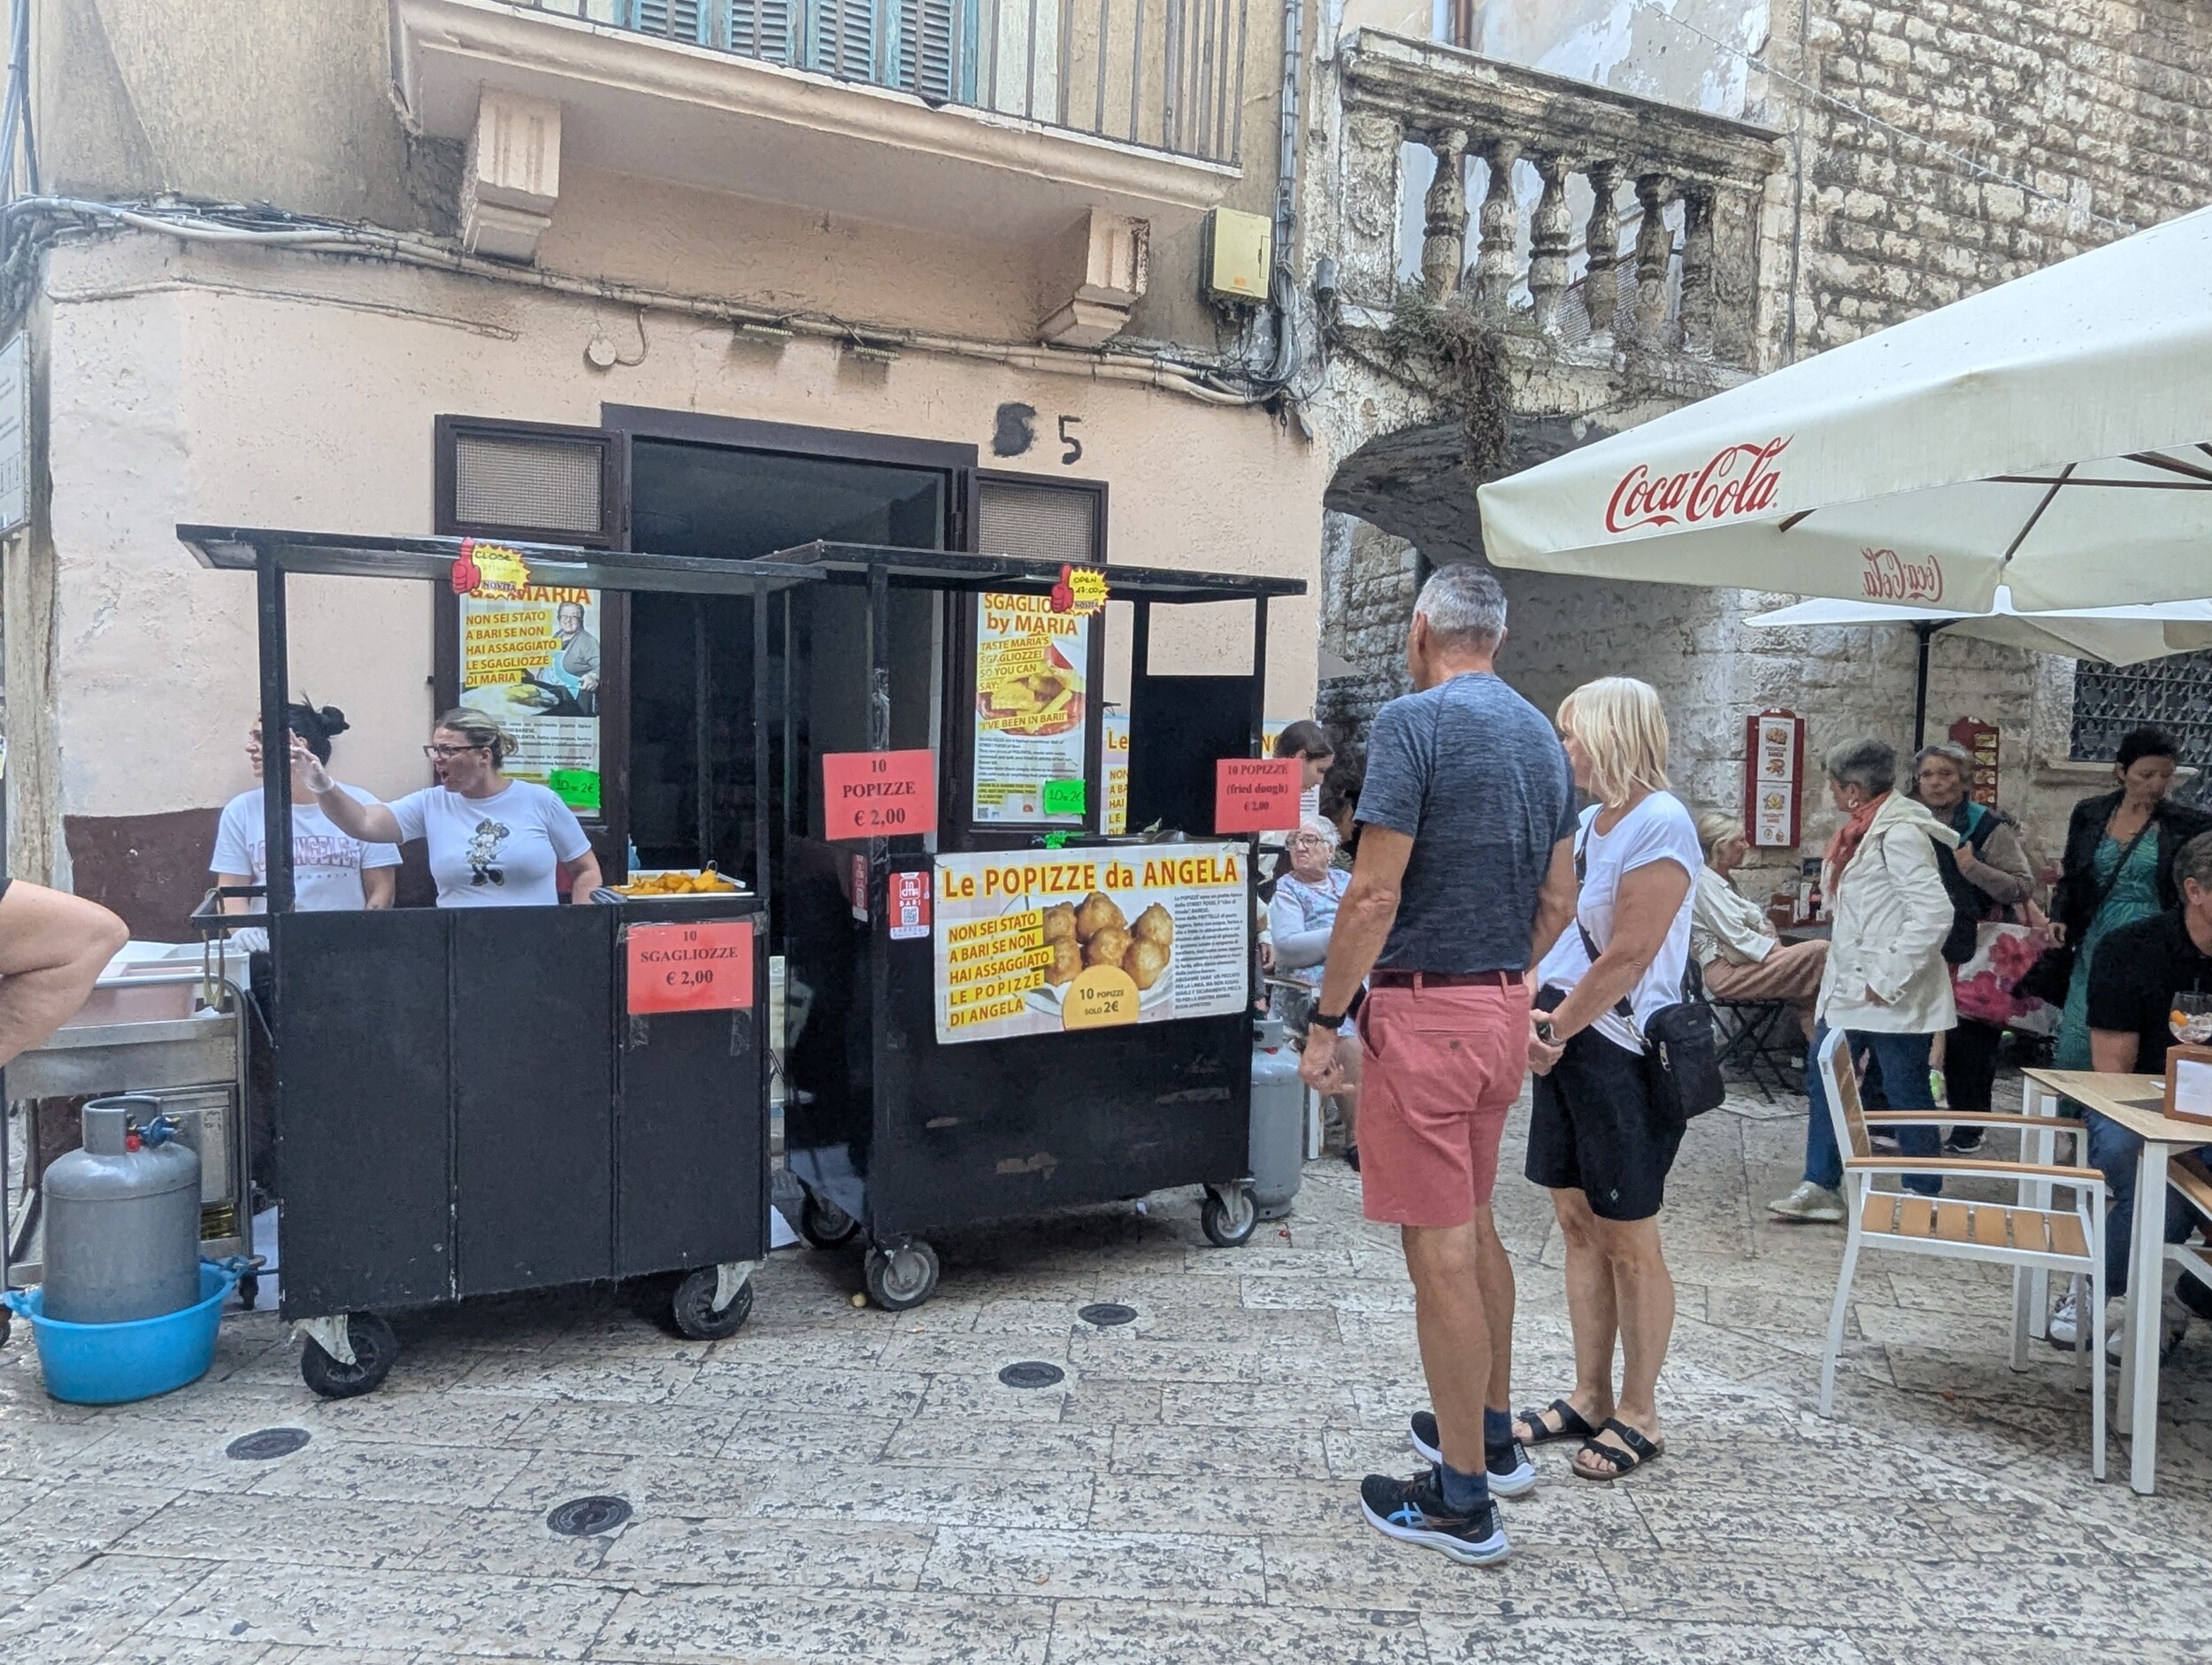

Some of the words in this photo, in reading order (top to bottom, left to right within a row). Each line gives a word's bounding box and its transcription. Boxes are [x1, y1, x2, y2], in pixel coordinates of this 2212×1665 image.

[1059, 414, 1082, 464] 5
[1605, 433, 1795, 533] Coca-Cola
[984, 593, 1051, 613] SGAGLIO
[465, 615, 490, 625] NON
[493, 613, 510, 624] SEI
[512, 611, 546, 623] STATO
[987, 612, 1010, 634] by
[1015, 615, 1078, 635] MARIA
[465, 631, 473, 640] A
[476, 629, 501, 640] BARI
[503, 627, 517, 638] SE
[519, 626, 544, 637] NON
[465, 645, 485, 656] HAI
[488, 641, 557, 654] ASSAGGIATO
[980, 641, 1010, 651] TASTE
[1010, 637, 1049, 648] MARIA'S
[465, 660, 478, 671] LE
[480, 656, 549, 669] SGAGLIOZZE
[979, 669, 994, 679] SO
[995, 666, 1014, 676] YOU
[1017, 664, 1037, 673] CAN
[465, 675, 477, 686] DI
[480, 673, 516, 684] MARIA
[979, 681, 1000, 691] SAY:
[1002, 717, 1026, 727] BEEN
[1028, 715, 1039, 725] IN
[1108, 731, 1127, 749] Le
[872, 759, 887, 772] 10
[1227, 766, 1238, 775] 10
[1240, 764, 1288, 775] POPIZZE
[843, 781, 916, 798] POPIZZE
[1109, 786, 1116, 794] A
[1226, 784, 1252, 794] (fried
[1255, 783, 1288, 794] dough)
[1109, 798, 1125, 809] HAI
[1244, 802, 1251, 810] €
[854, 810, 865, 826] €
[871, 808, 906, 828] 2,00
[1109, 813, 1120, 824] LE
[945, 871, 973, 898] Le
[987, 864, 1095, 895] POPIZZE
[1106, 863, 1133, 888] da
[1143, 857, 1238, 886] ANGELA
[949, 925, 977, 943] NON
[979, 920, 997, 936] SEI
[1000, 912, 1036, 932] STATO
[683, 931, 697, 941] 10
[641, 947, 738, 963] SGAGLIOZZE
[949, 950, 958, 963] A
[961, 943, 989, 962] BARI
[992, 940, 1006, 955] SE
[1009, 932, 1035, 950] NON
[949, 968, 972, 985] HAI
[974, 951, 1049, 979] ASSAGGIATO
[666, 971, 676, 986] €
[680, 969, 714, 986] 2,00
[950, 990, 967, 1006] LE
[975, 973, 1041, 1000] POPIZZE
[1079, 988, 1094, 1000] 10
[1096, 989, 1125, 998] POPIZZE
[950, 1011, 964, 1026] DI
[970, 998, 1024, 1023] ANGELA
[1084, 1007, 1102, 1016] SOLO
[1103, 1001, 1118, 1013] 2€
